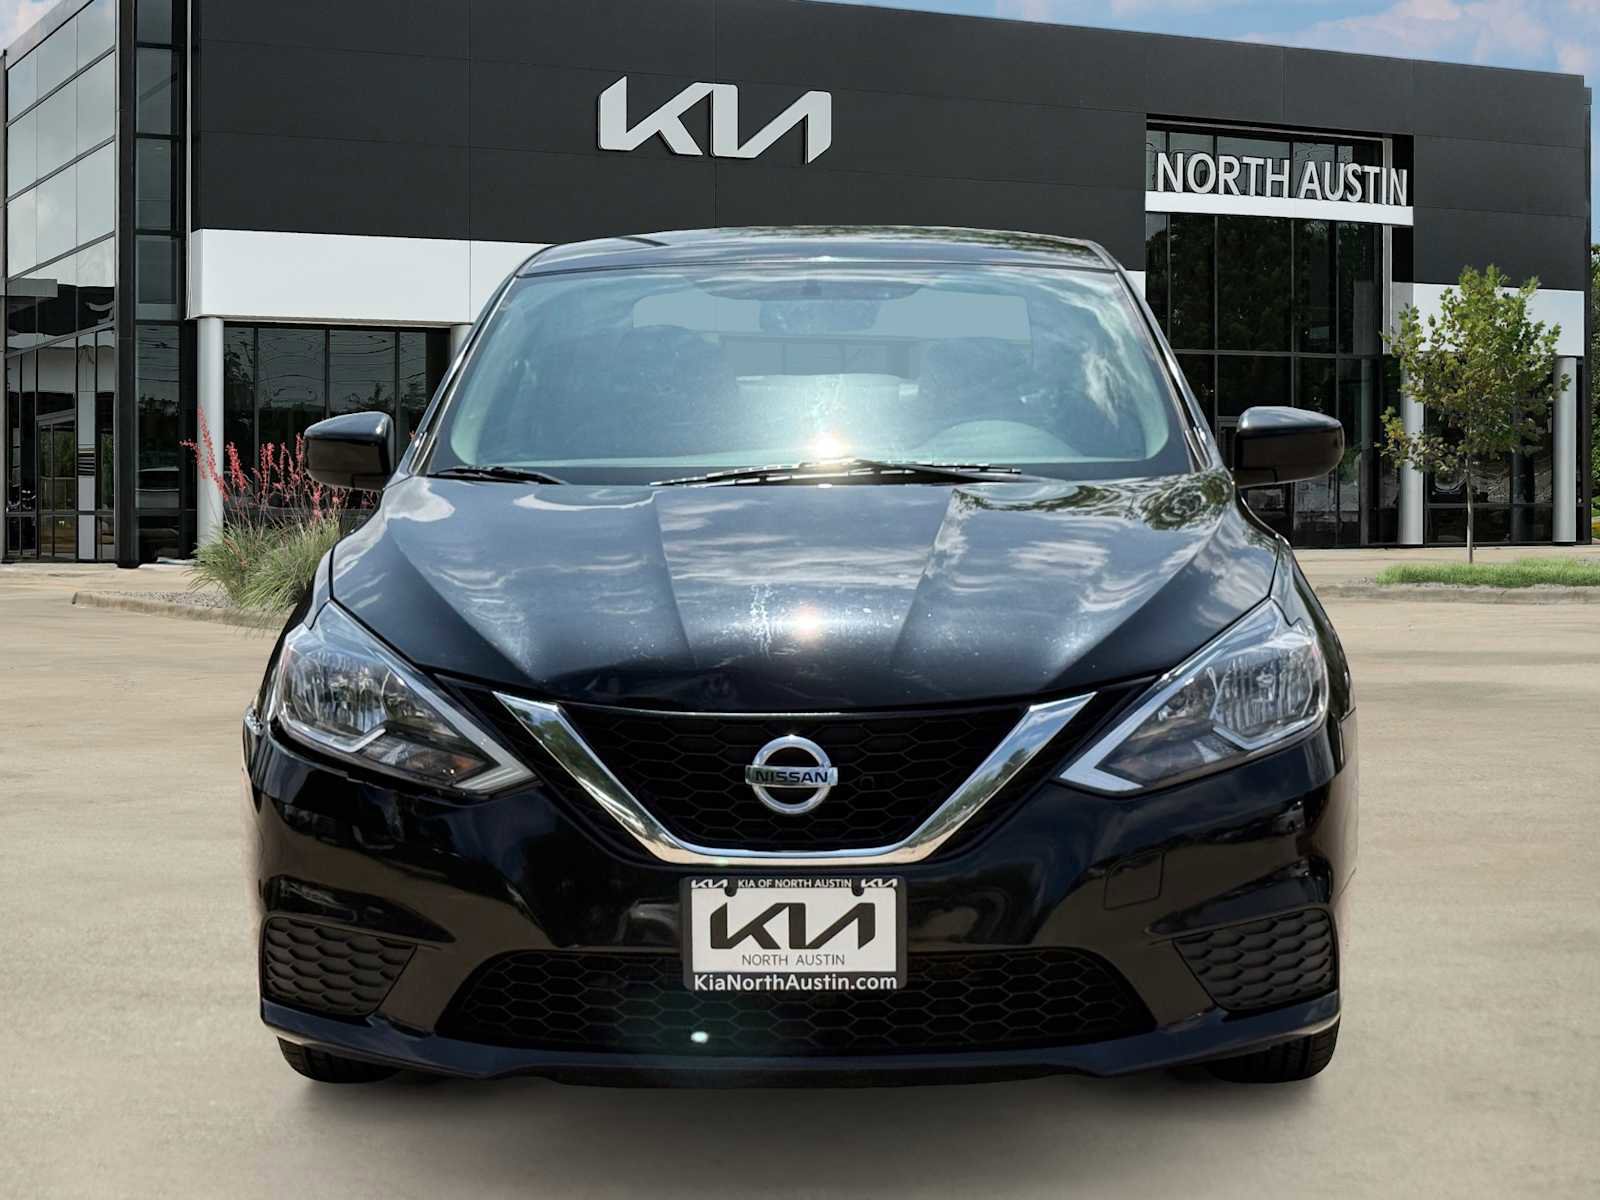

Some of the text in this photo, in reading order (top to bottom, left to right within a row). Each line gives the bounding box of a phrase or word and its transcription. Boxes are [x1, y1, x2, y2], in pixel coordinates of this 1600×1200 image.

[599, 76, 832, 164] KIA
[1157, 152, 1408, 206] NORTH AUSTIN
[755, 771, 828, 783] NISSAN
[691, 879, 728, 889] KIA
[738, 879, 852, 888] KIA OF NORTH AUSTIN
[861, 878, 898, 888] KIA
[710, 902, 876, 950] KIA
[742, 954, 845, 966] NORTH AUSTIN
[694, 974, 897, 992] KiaNorthAustin.com
